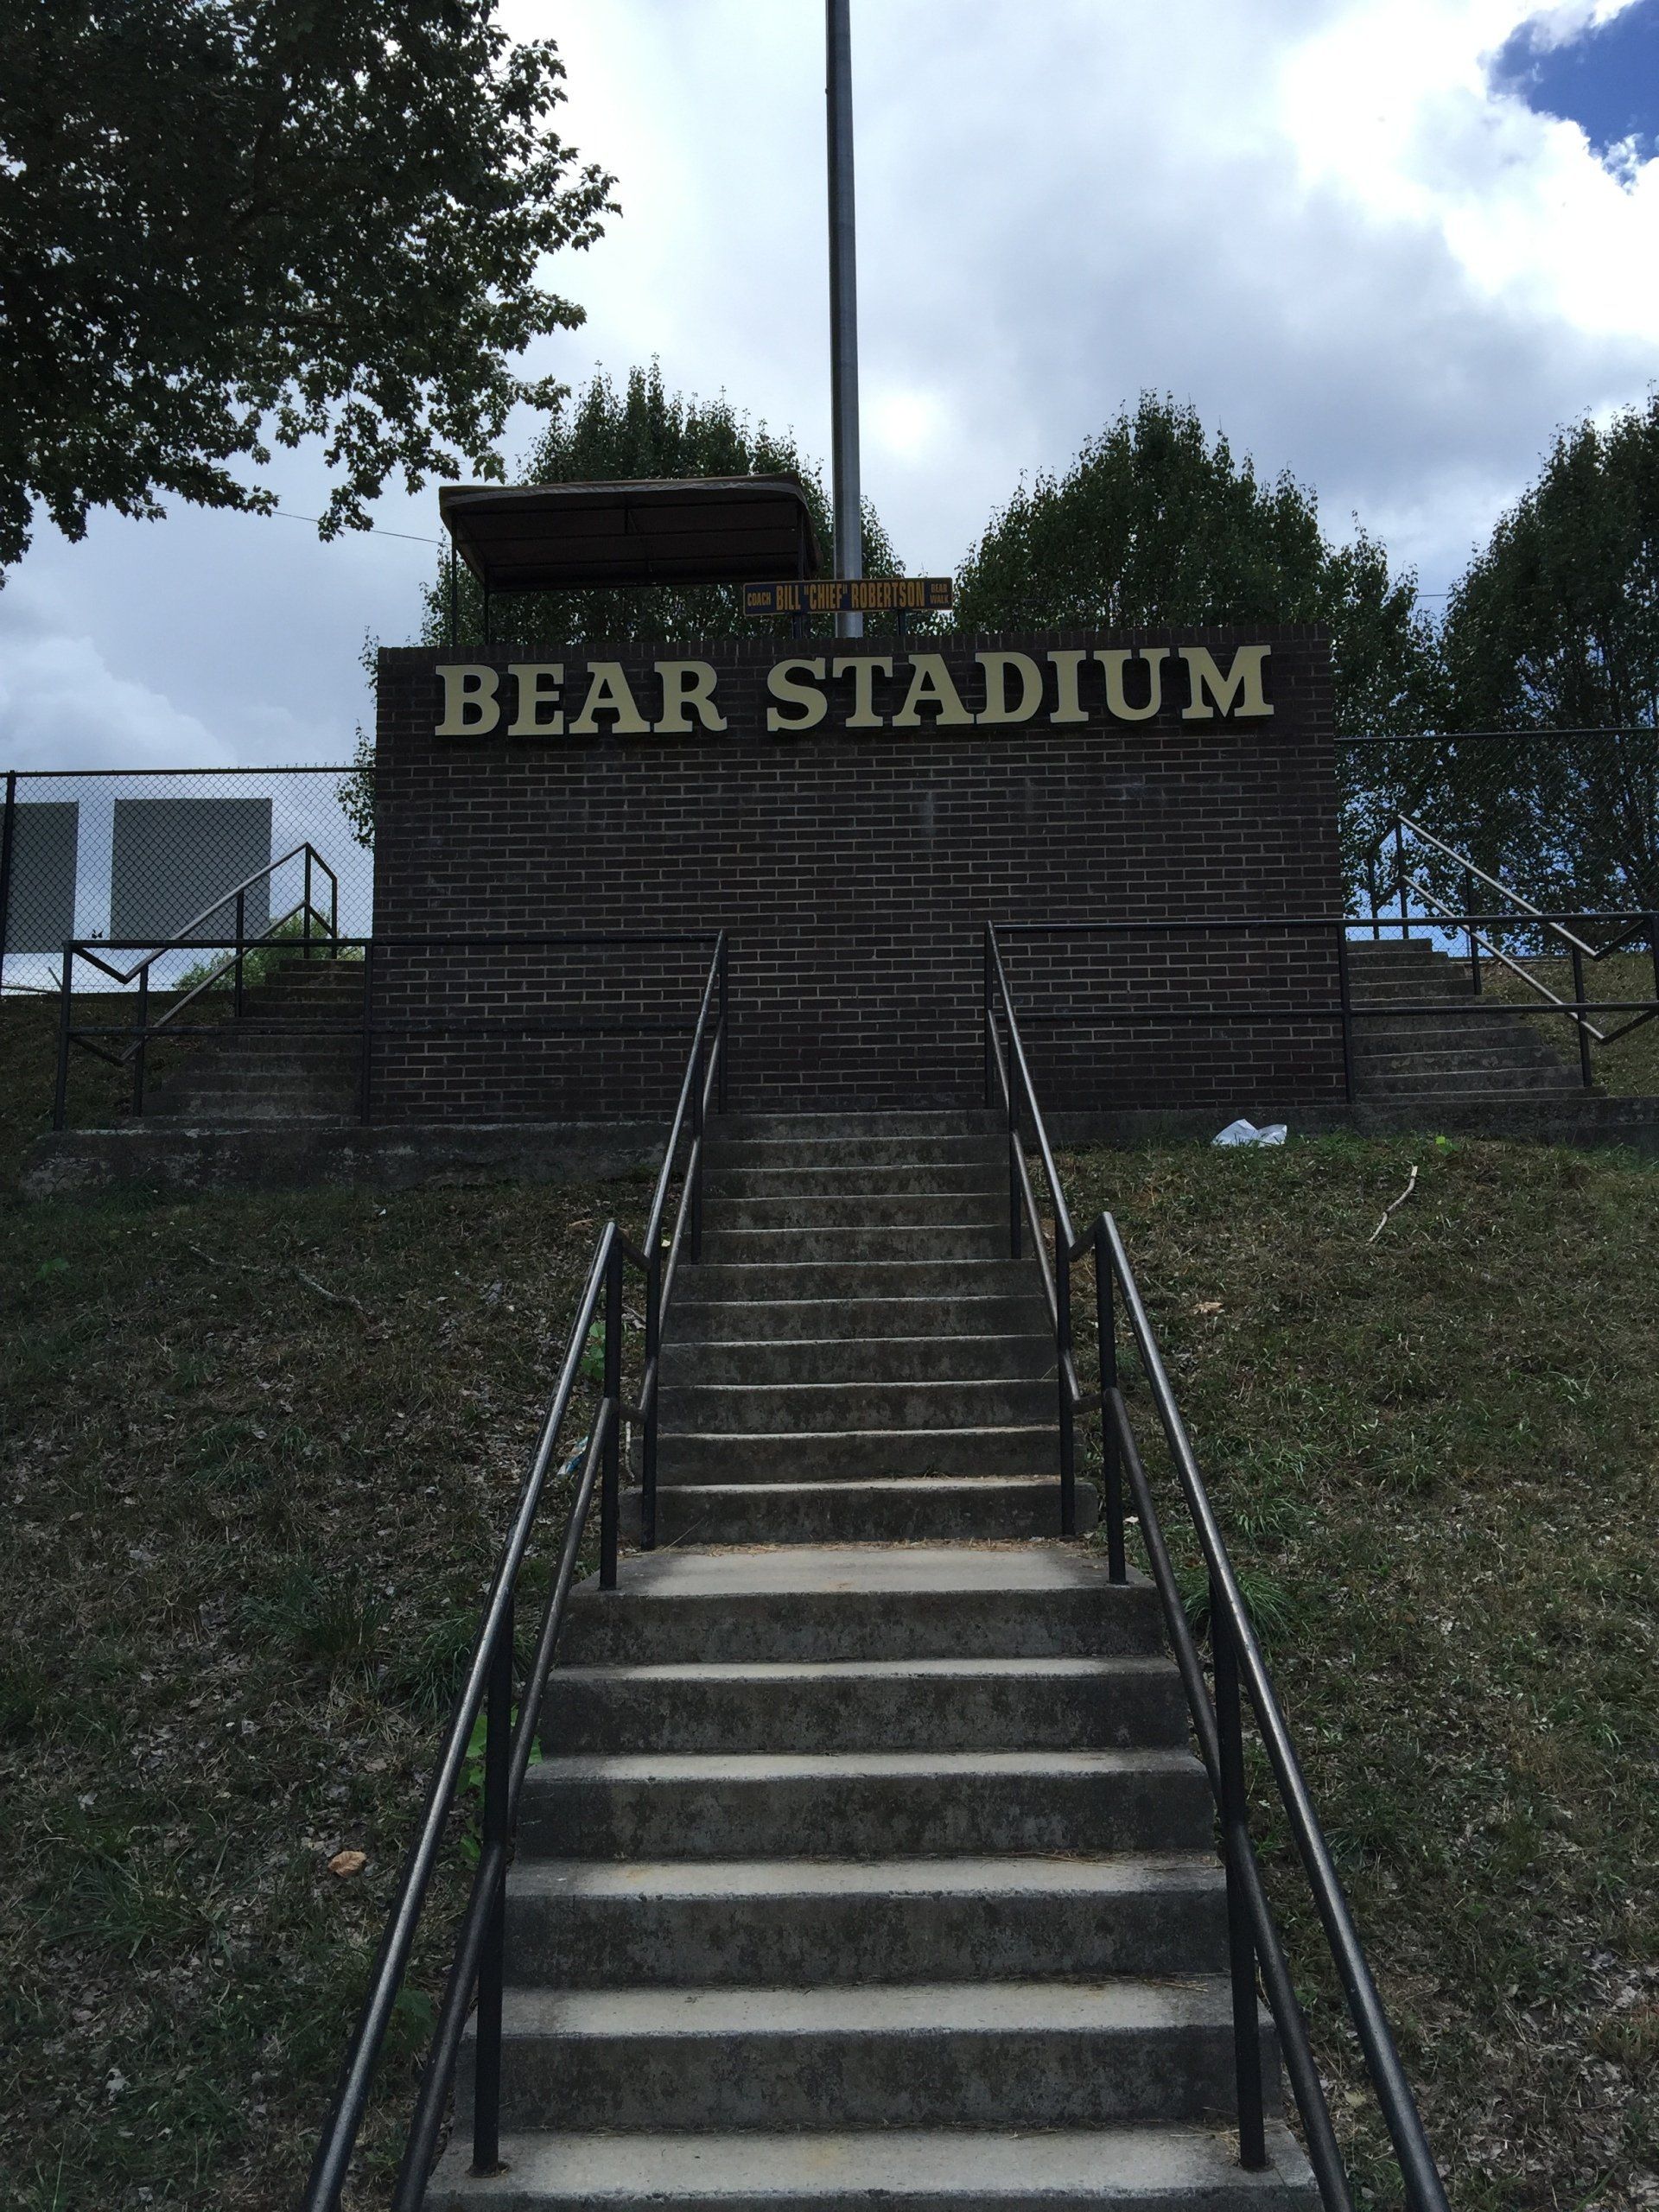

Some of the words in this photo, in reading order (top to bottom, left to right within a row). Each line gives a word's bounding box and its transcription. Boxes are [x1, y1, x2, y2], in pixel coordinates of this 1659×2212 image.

[747, 592, 772, 607] COACH
[776, 585, 801, 610] BILL
[804, 583, 848, 610] "CHIEF"
[851, 582, 925, 609] ROBERTSON
[931, 583, 948, 594] BEAR
[930, 594, 949, 605] WALK
[434, 660, 728, 736] BEAR
[766, 645, 1274, 732] STADIUM
